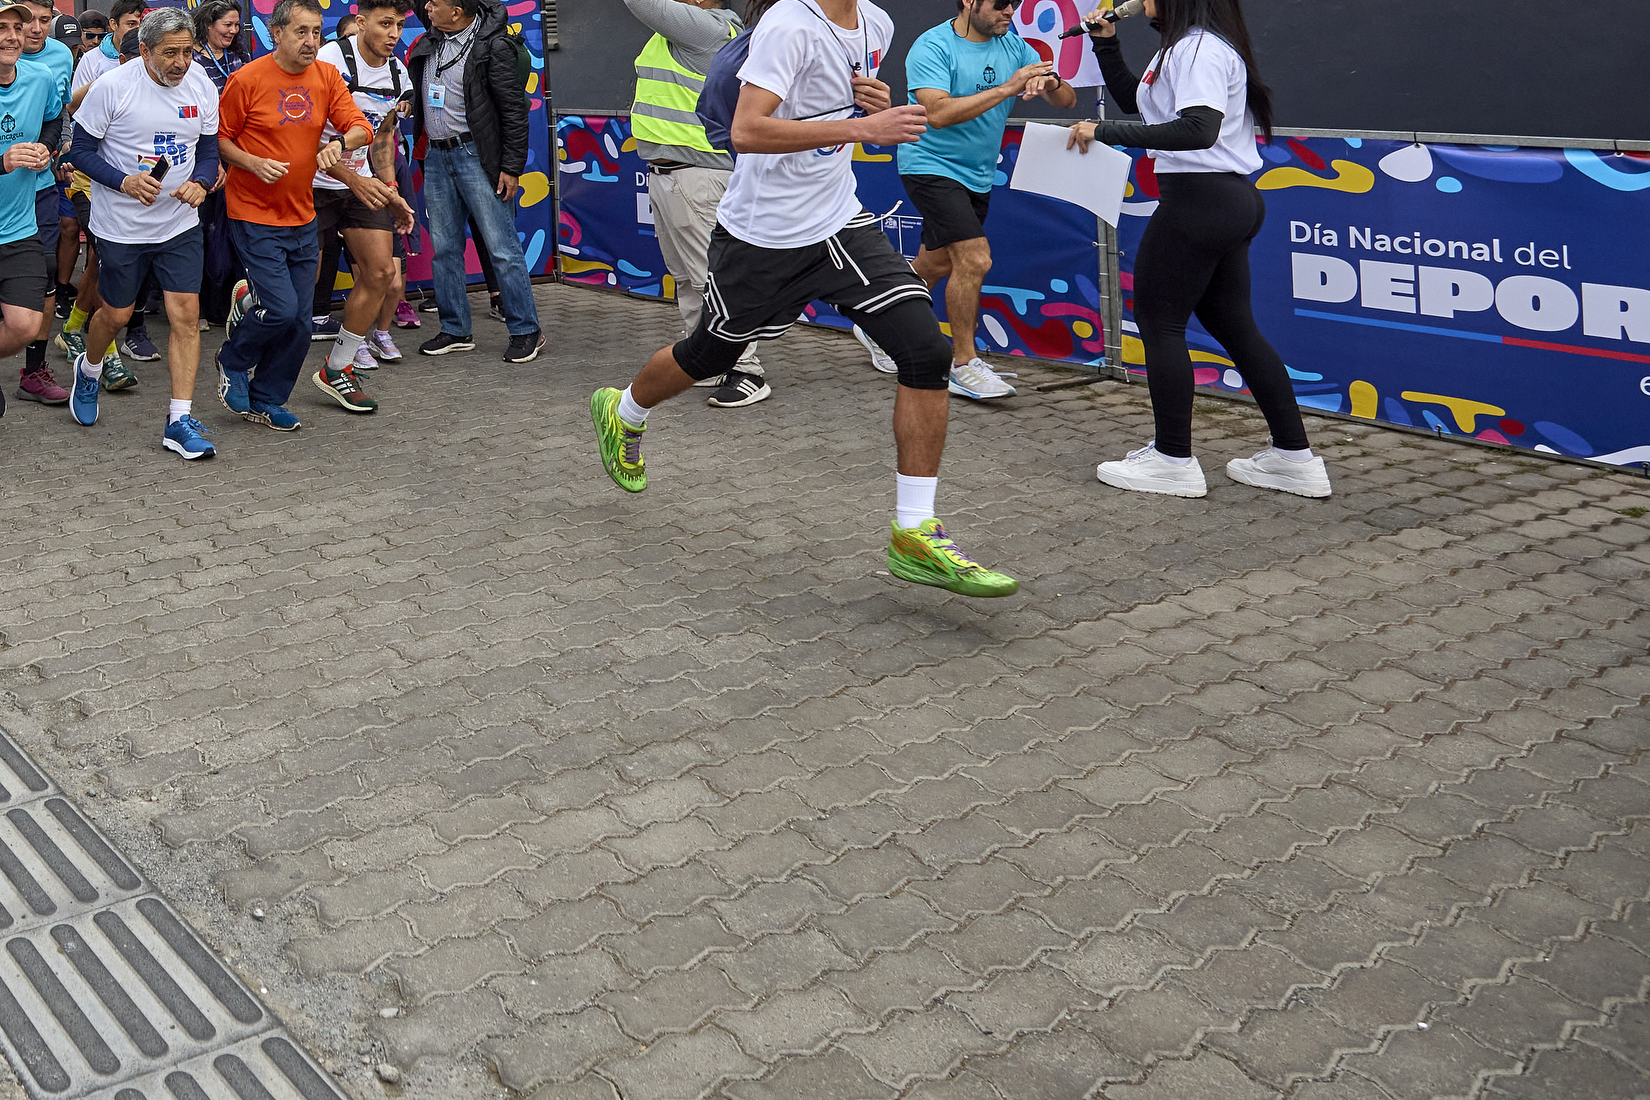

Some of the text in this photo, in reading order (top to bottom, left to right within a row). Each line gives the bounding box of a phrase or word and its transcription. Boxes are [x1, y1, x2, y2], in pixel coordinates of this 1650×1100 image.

[154, 135, 176, 145] DE
[154, 144, 188, 156] POR
[172, 153, 187, 166] TE
[636, 171, 649, 187] Dí
[1290, 220, 1571, 270] Día Nacional del
